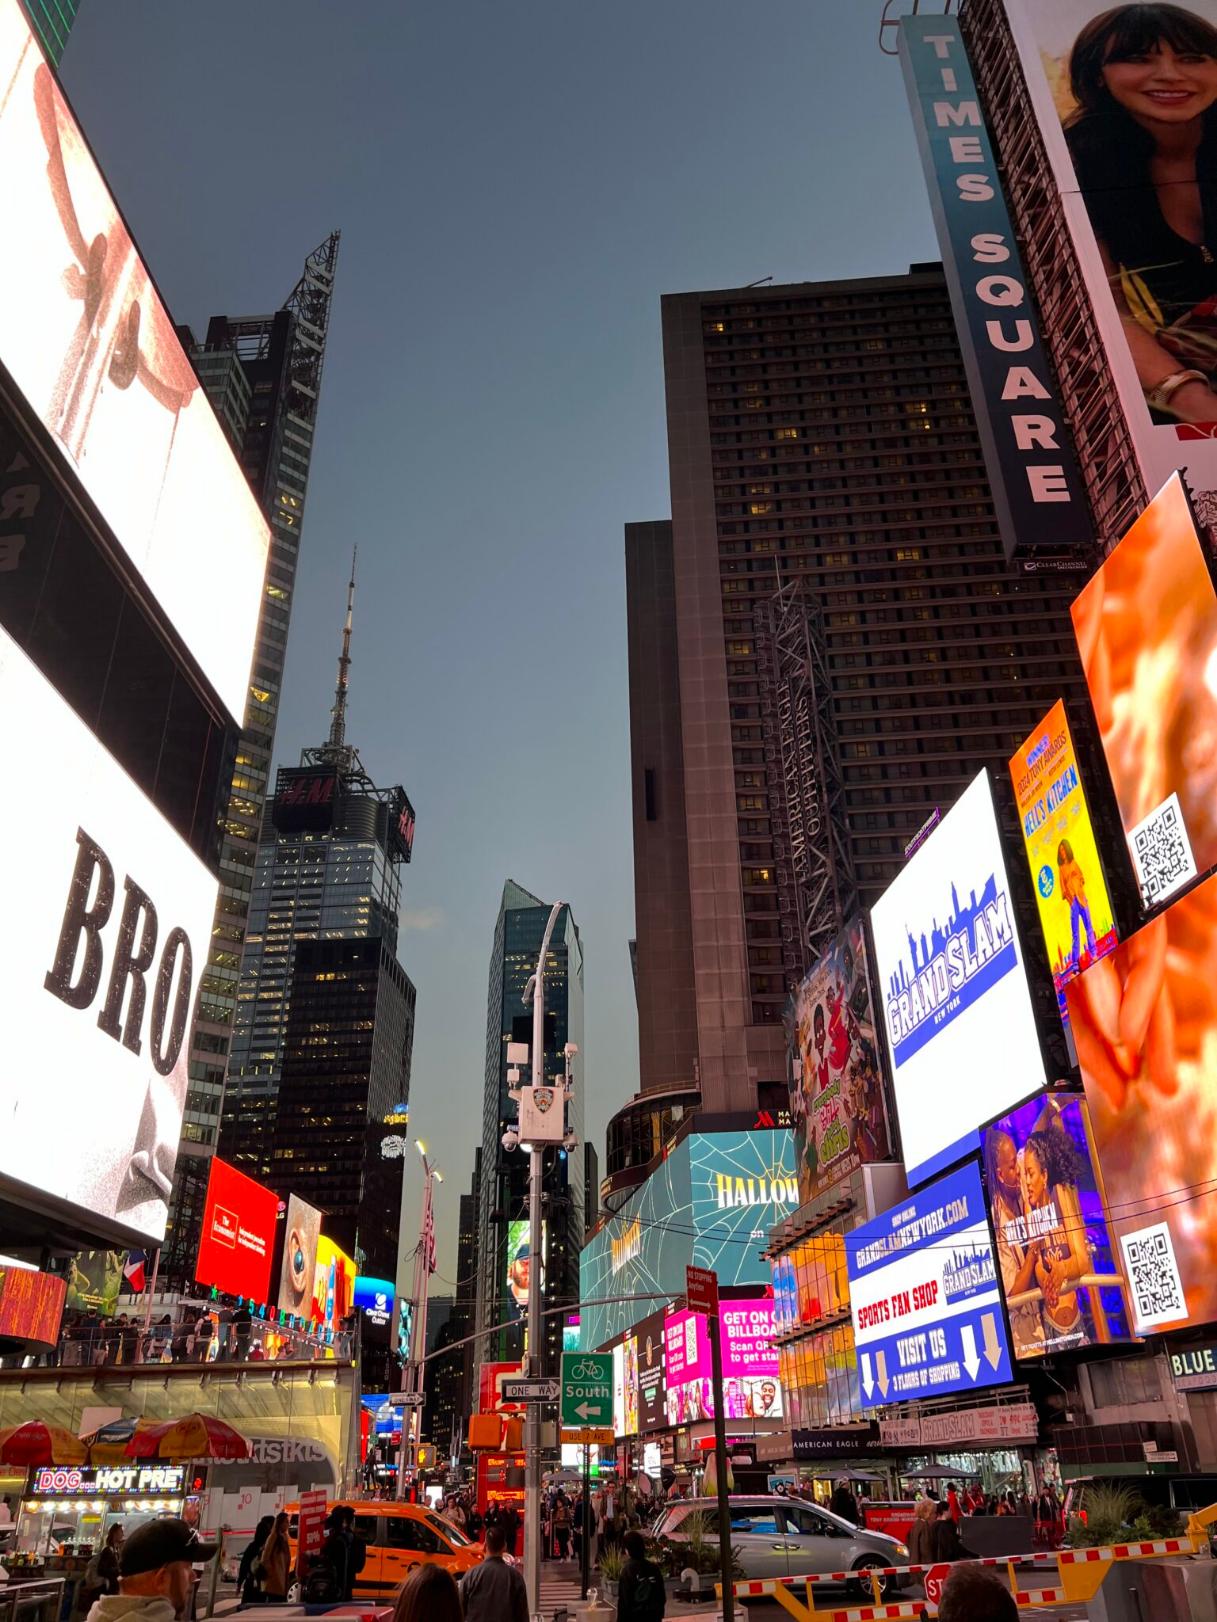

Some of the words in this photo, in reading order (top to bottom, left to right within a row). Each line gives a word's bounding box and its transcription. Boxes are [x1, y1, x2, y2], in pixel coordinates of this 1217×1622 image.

[923, 34, 995, 202] TIMES
[970, 233, 1071, 503] SQUARE
[1029, 758, 1044, 780] TONY
[1044, 731, 1067, 766] AWARDS
[1024, 799, 1046, 838] HELL'S
[1046, 764, 1078, 814] KITCHEN
[44, 825, 193, 1077] BRO
[947, 995, 961, 1013] YORK
[723, 1312, 747, 1325] GET
[750, 1312, 768, 1324] ON
[858, 1299, 890, 1330] SPORTS
[891, 1291, 911, 1318] FAN
[912, 1280, 938, 1311] SHOP
[730, 1341, 752, 1351] Scan
[731, 1353, 740, 1363] to
[743, 1353, 759, 1364] get
[897, 1333, 927, 1367] VISIT
[929, 1328, 947, 1359] US
[898, 1371, 920, 1390] FLOORS
[920, 1368, 928, 1387] OF
[928, 1361, 960, 1385] SHOPPING
[1171, 1349, 1215, 1376] BLUE
[511, 1386, 529, 1396] ONE
[538, 1385, 557, 1395] WAY
[566, 1385, 609, 1398] South
[794, 1441, 833, 1449] AMERICAN
[836, 1440, 859, 1448] EAGLE
